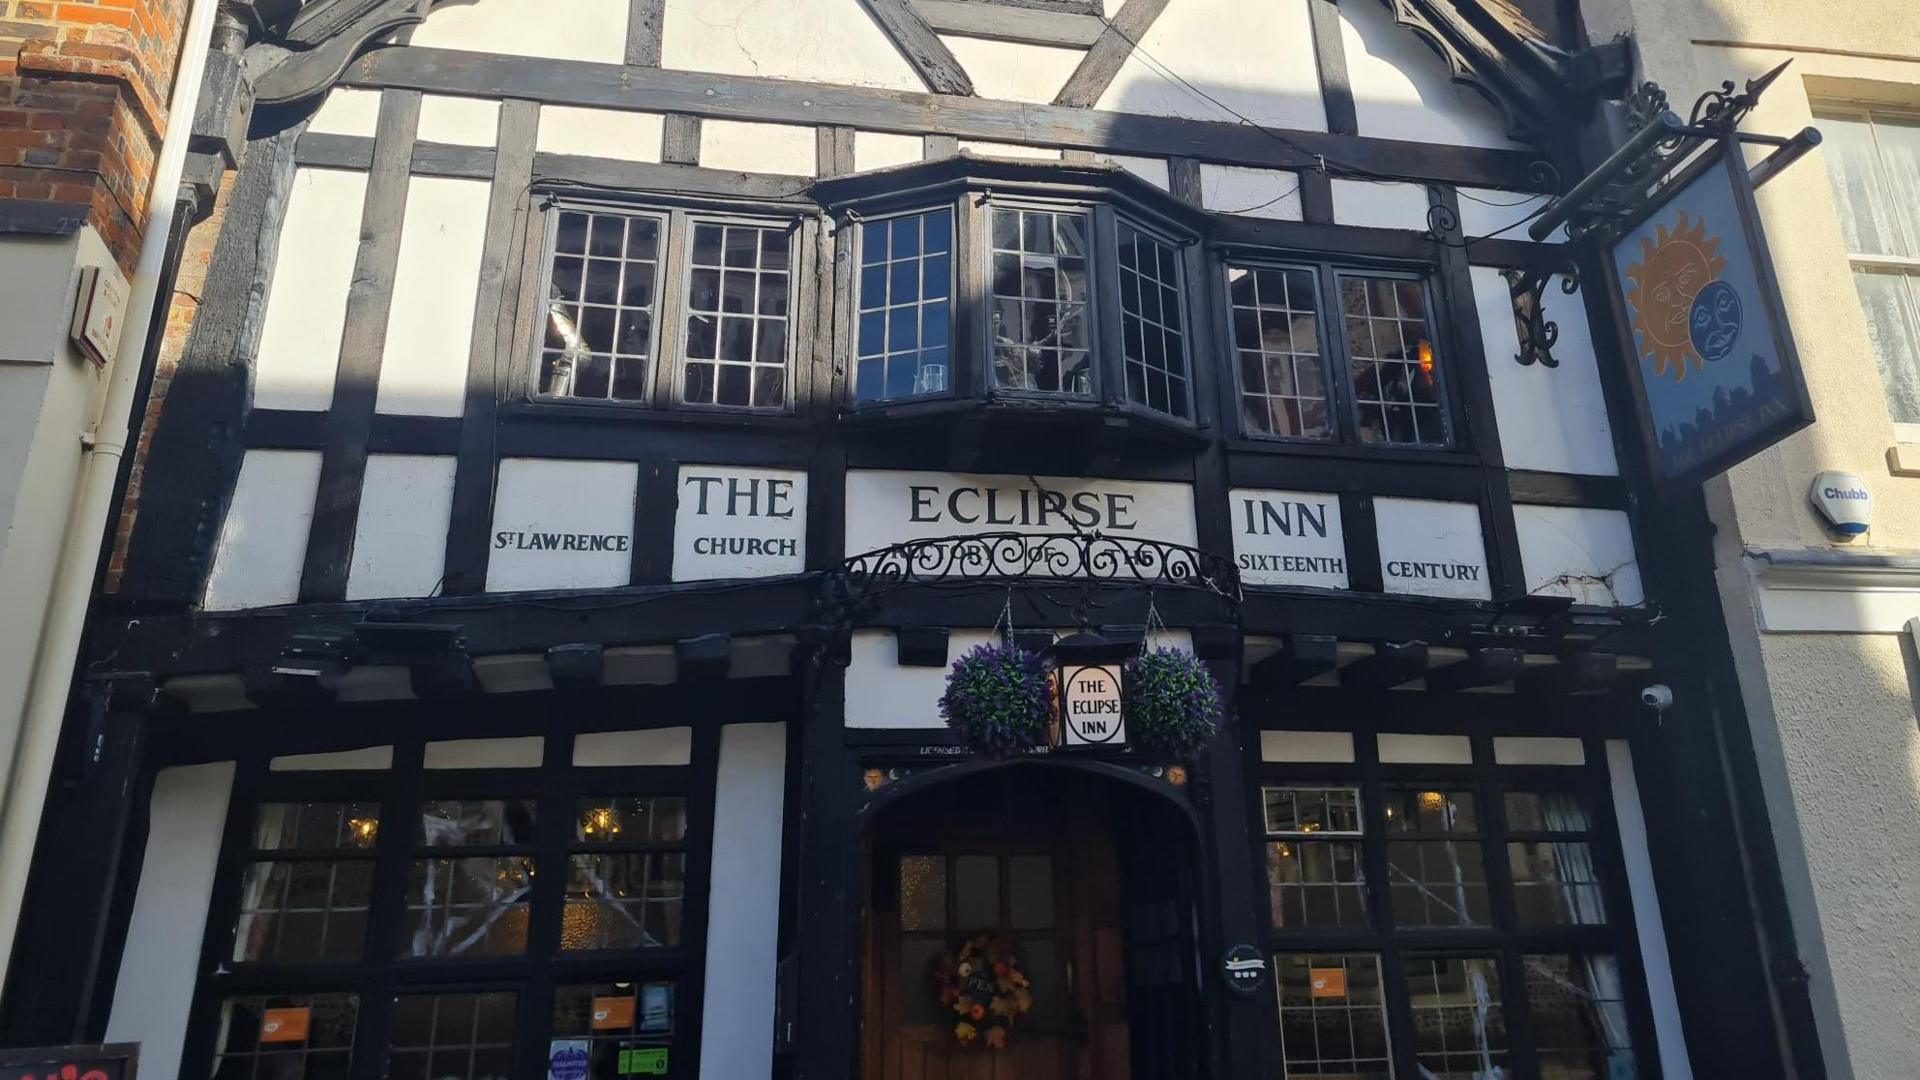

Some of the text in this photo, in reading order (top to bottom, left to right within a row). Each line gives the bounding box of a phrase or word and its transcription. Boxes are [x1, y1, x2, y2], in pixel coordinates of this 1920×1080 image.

[1824, 487, 1869, 502] Chubb
[685, 475, 1327, 538] THE ECLIPSE INN
[516, 532, 629, 553] LAWRENCE
[693, 537, 797, 557] CHURCH
[1239, 553, 1344, 575] SIXTEENTH
[1386, 561, 1480, 581] CENTURY
[1078, 679, 1106, 694] THE
[1073, 699, 1120, 715] ECLIPSE
[1081, 720, 1108, 736] INN
